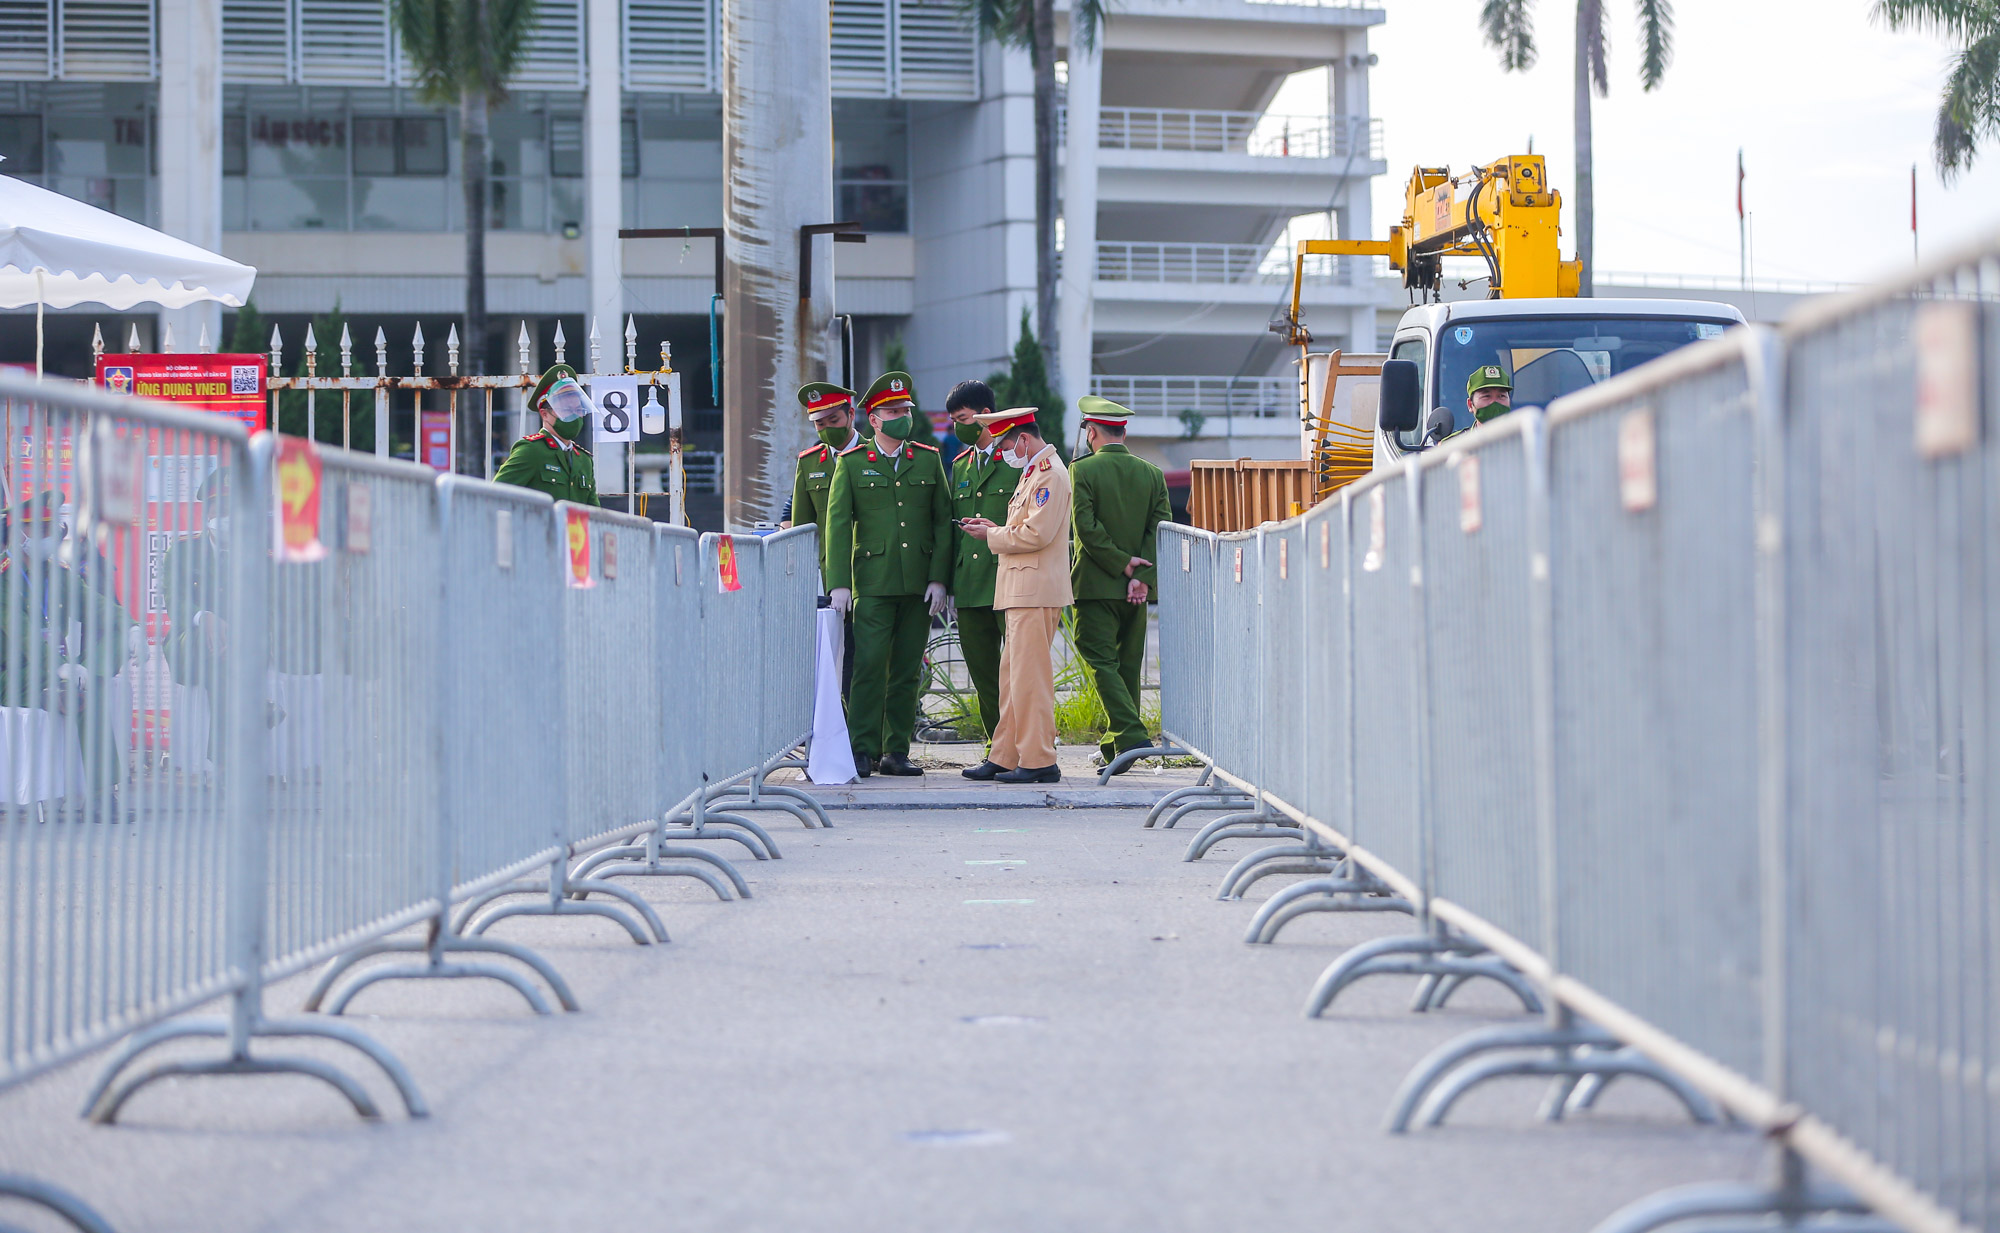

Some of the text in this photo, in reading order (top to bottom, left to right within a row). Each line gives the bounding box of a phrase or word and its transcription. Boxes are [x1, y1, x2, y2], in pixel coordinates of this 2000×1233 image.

[137, 381, 227, 399] ỨNG DỤNG VNEID
[603, 391, 629, 433] 8
